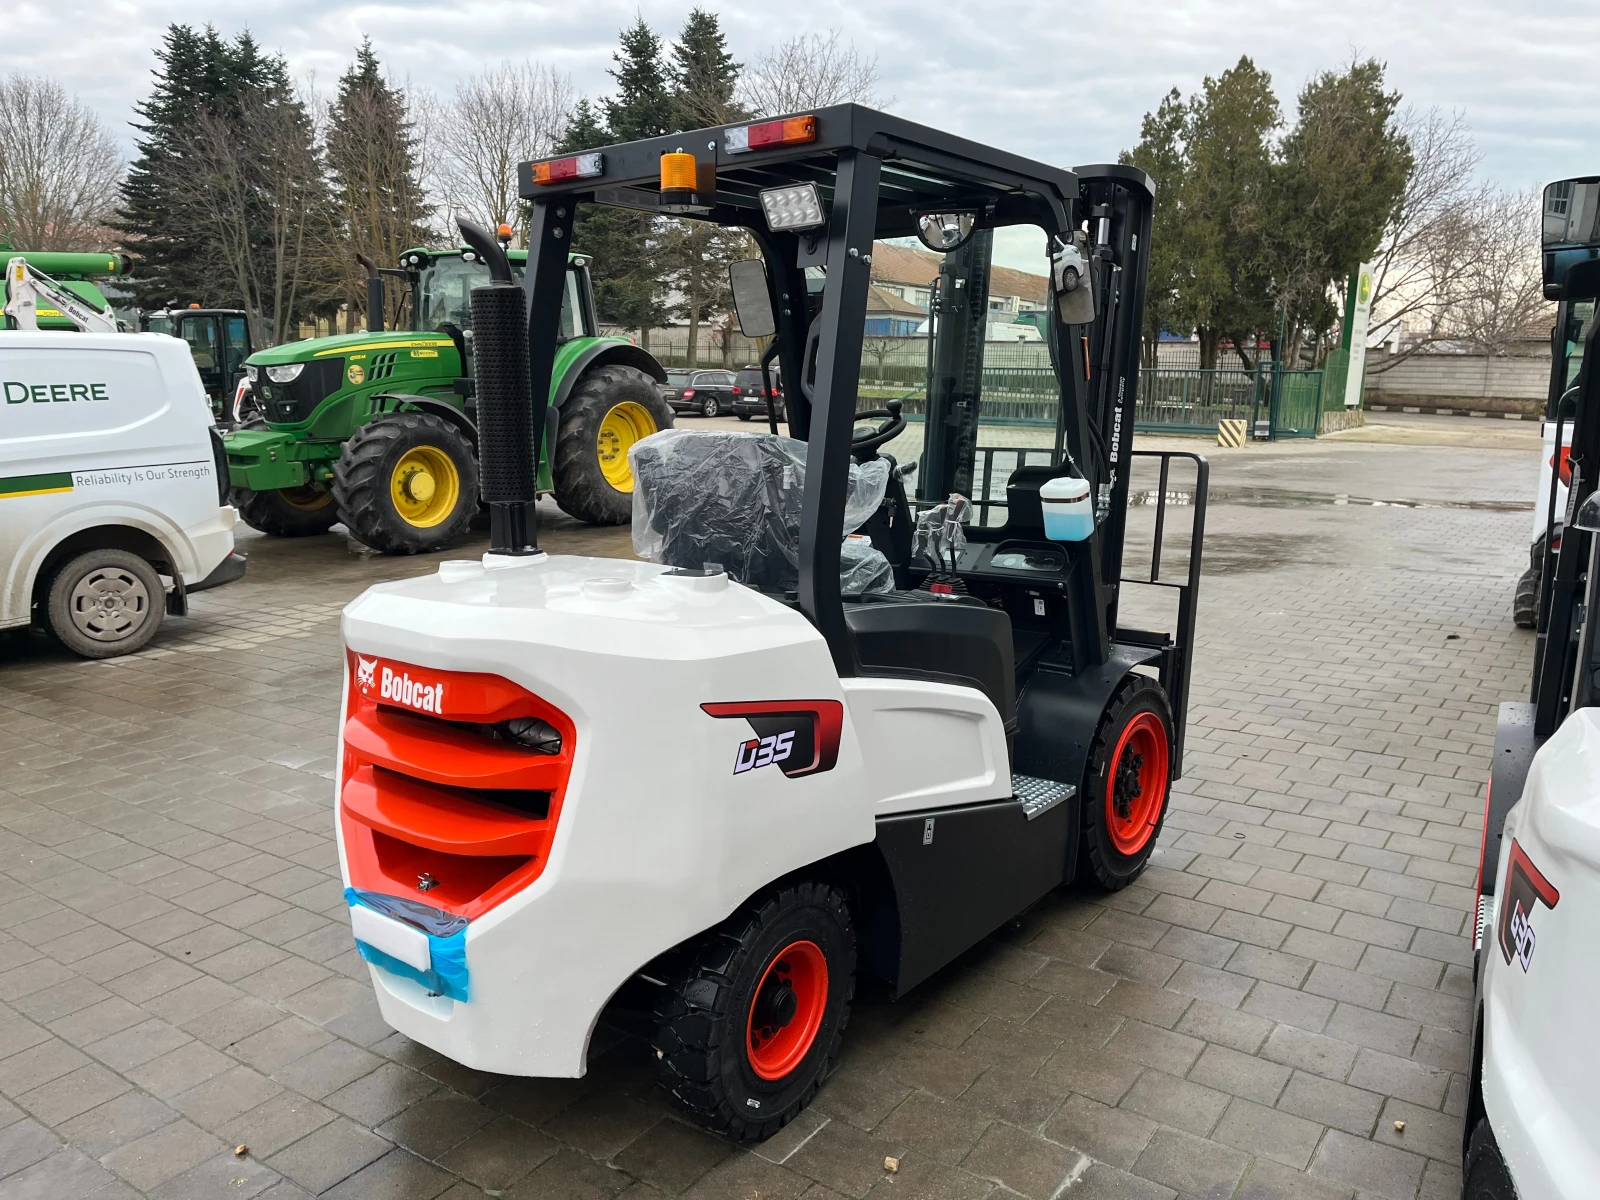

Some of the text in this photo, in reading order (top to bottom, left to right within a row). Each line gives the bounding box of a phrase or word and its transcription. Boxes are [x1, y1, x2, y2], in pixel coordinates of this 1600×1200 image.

[68, 306, 88, 323] Bobcat
[3, 381, 109, 404] DEERE
[1110, 407, 1122, 462] Bobcat
[76, 466, 210, 487] Reliability Is Our Strength
[381, 667, 443, 714] Bobcat
[734, 731, 795, 774] D35
